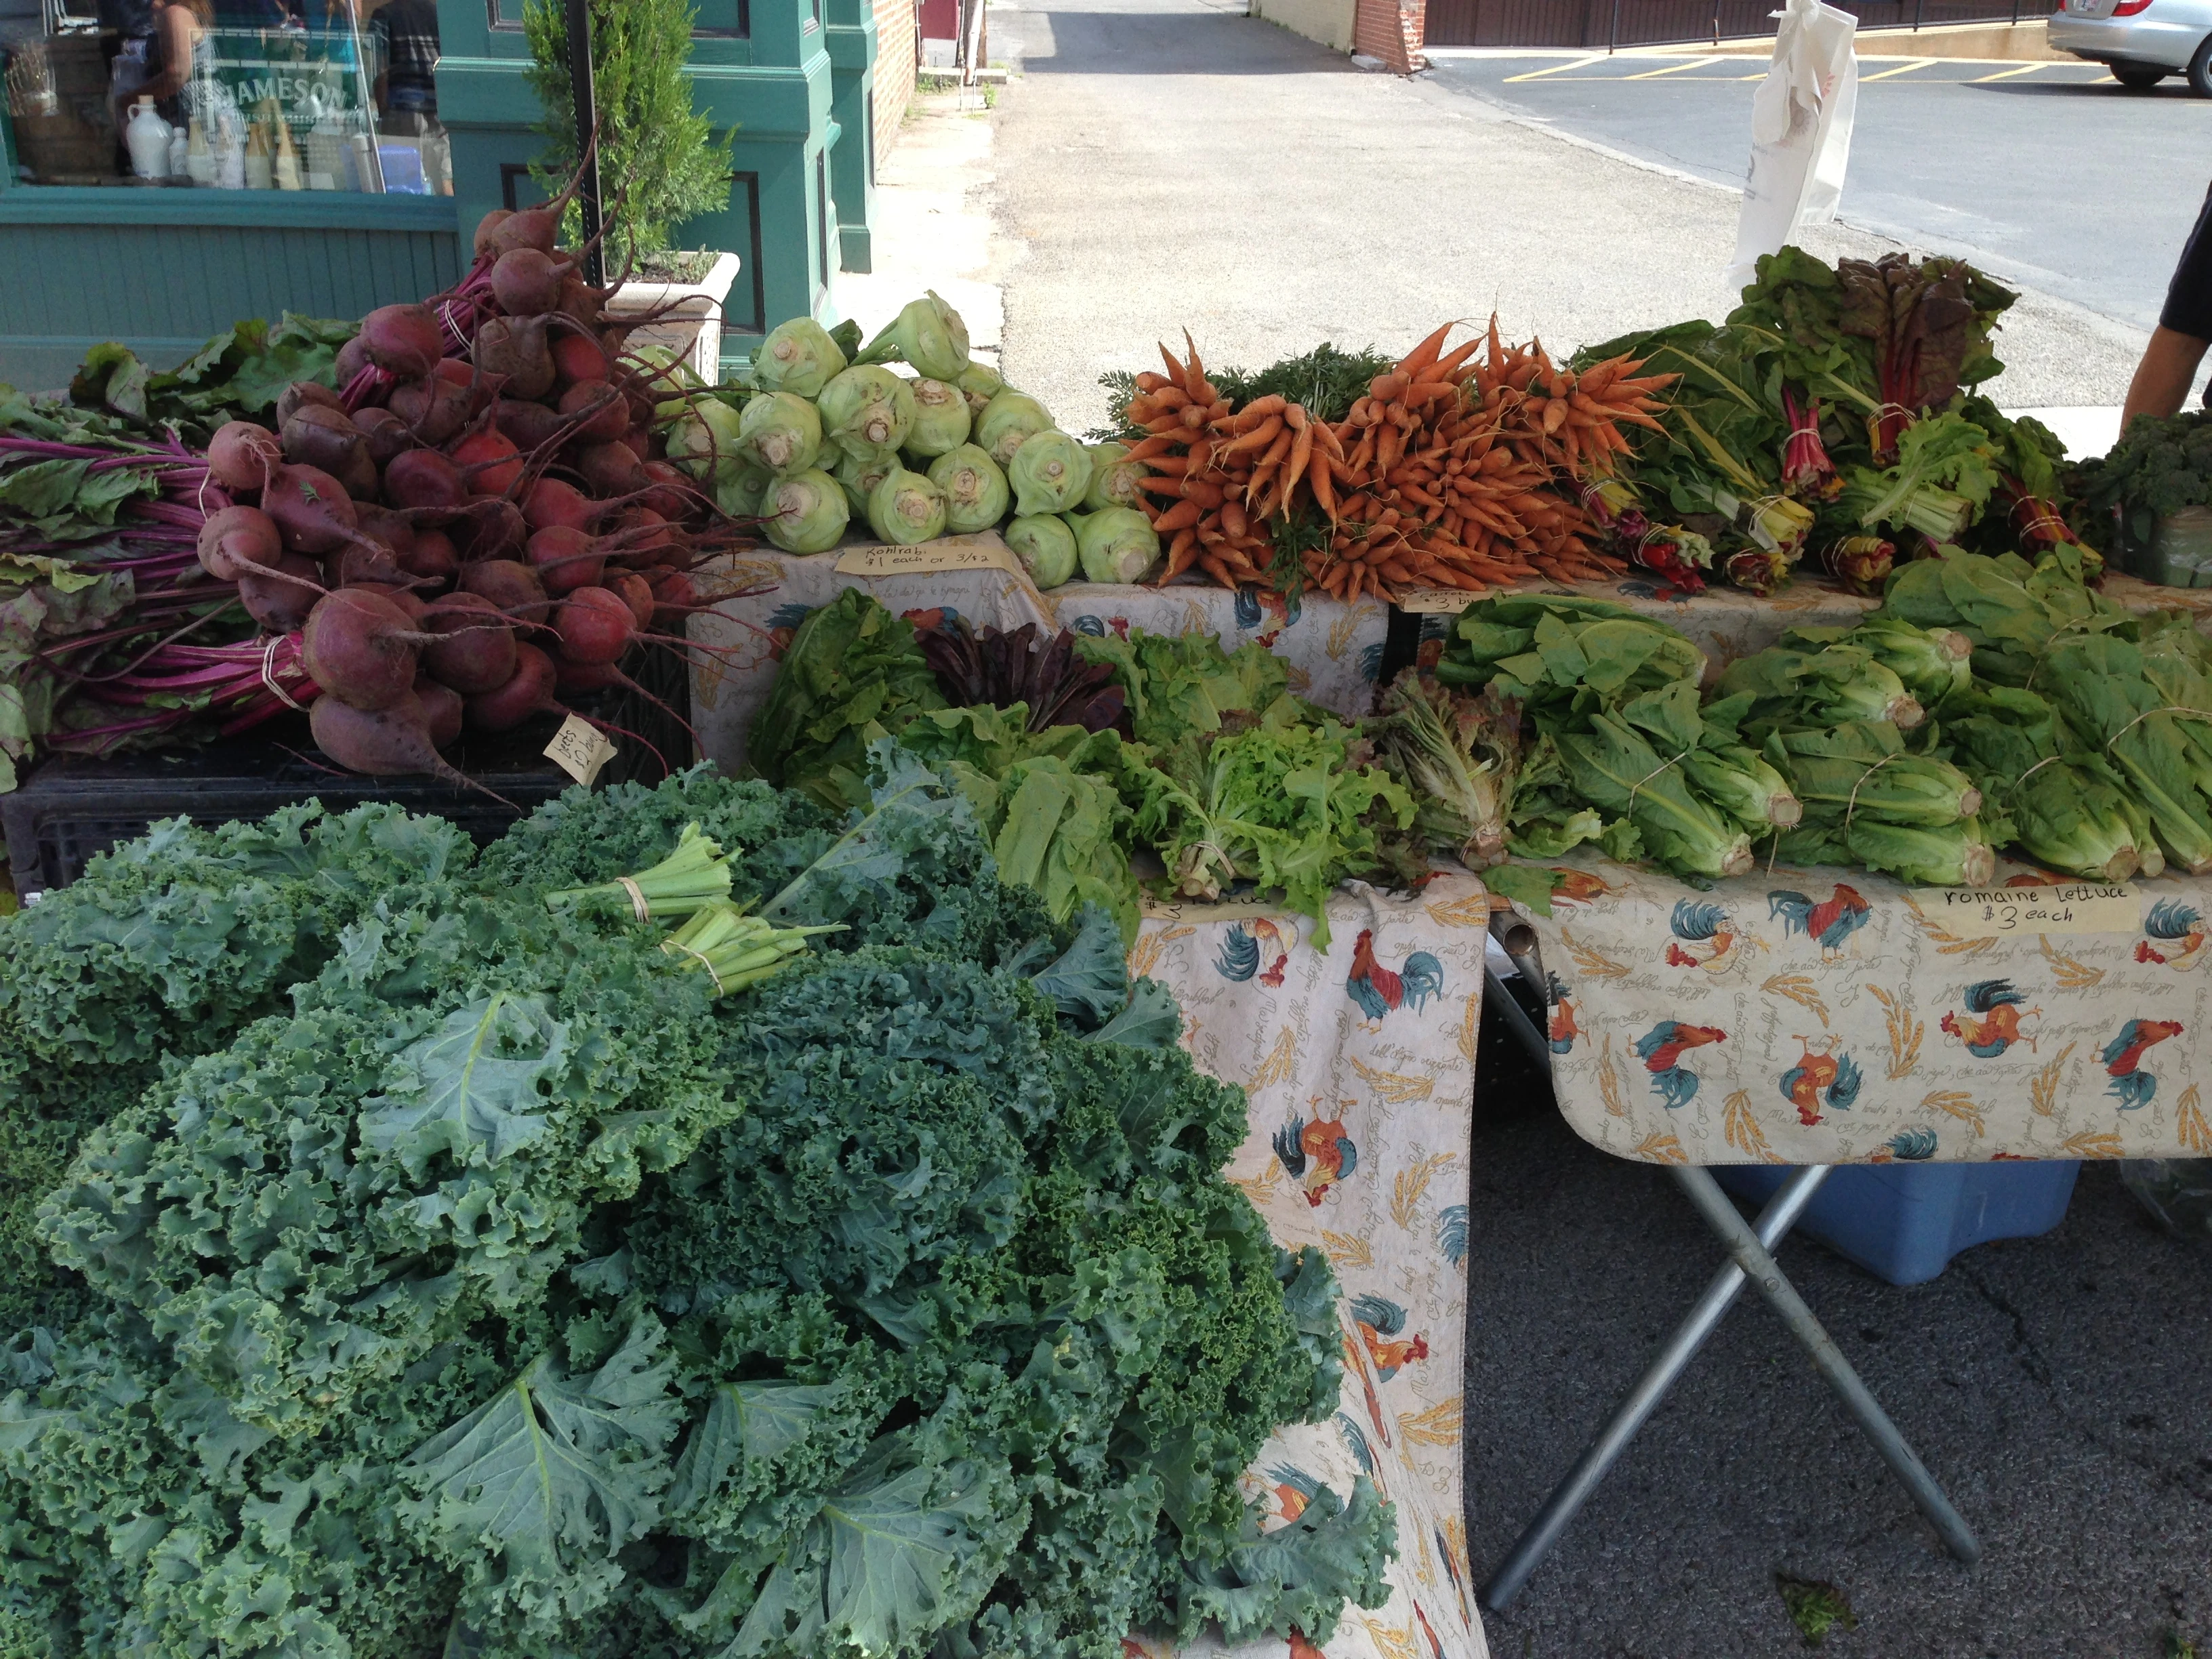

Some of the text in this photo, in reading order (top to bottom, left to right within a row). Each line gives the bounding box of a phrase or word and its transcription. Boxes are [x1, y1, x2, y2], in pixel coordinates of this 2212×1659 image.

[224, 77, 348, 110] JAMESON
[554, 729, 577, 760] beets
[1944, 890, 2039, 906] romaine
[1982, 905, 2074, 930] $3 each
